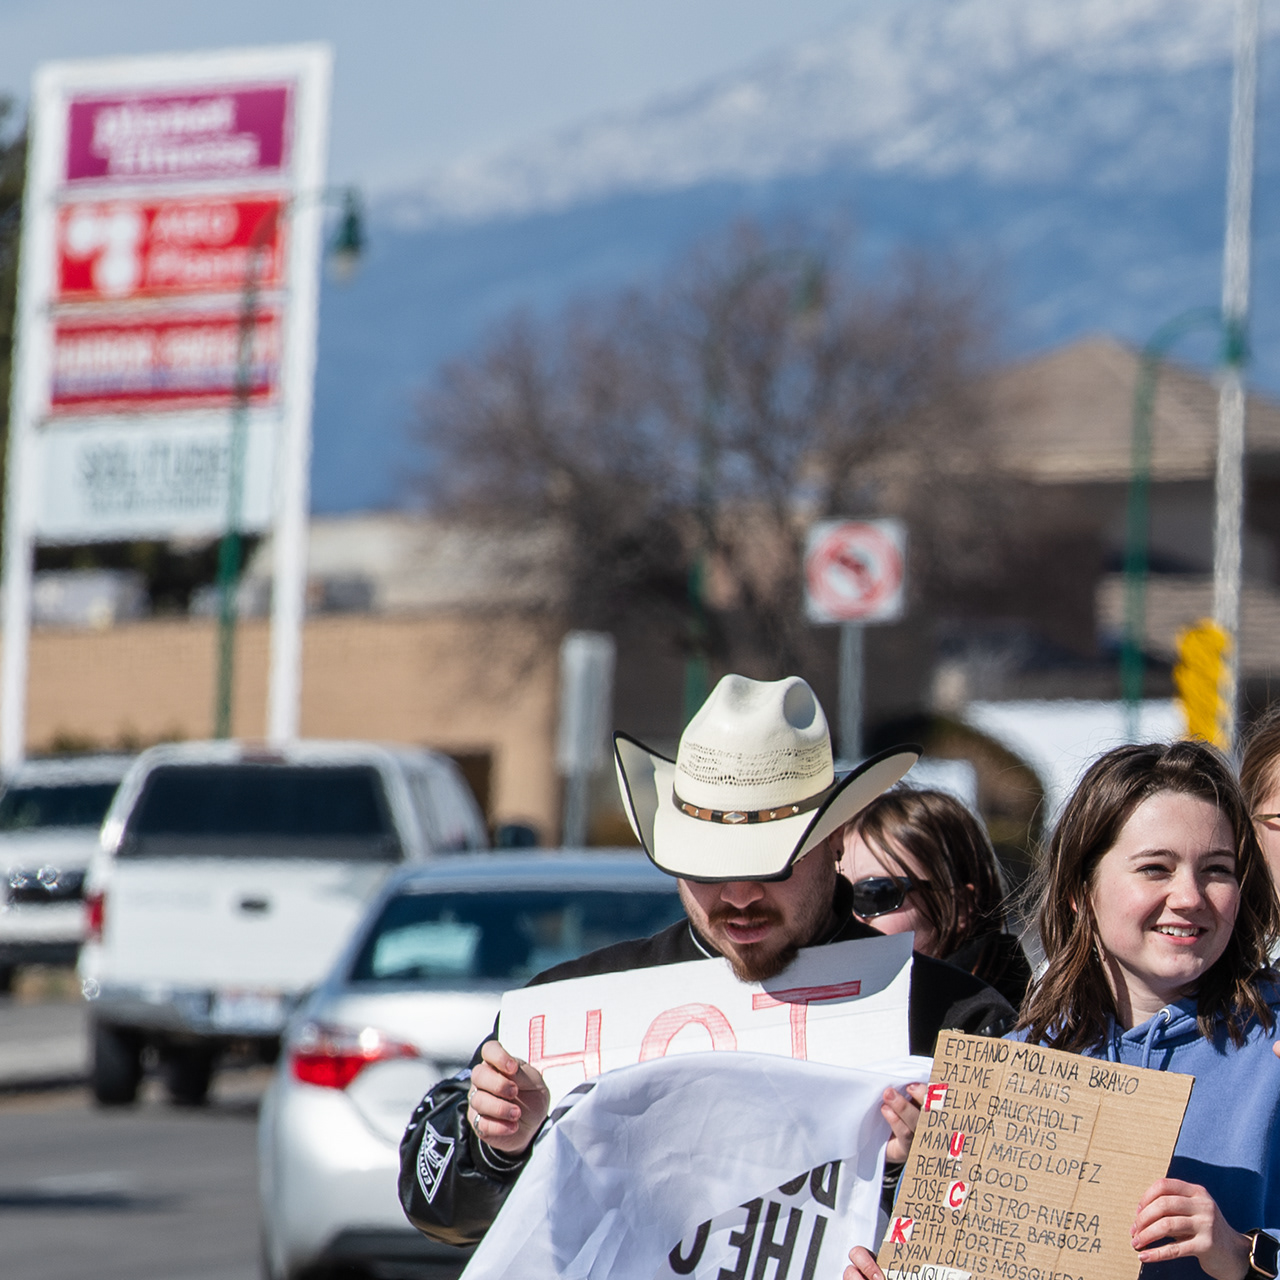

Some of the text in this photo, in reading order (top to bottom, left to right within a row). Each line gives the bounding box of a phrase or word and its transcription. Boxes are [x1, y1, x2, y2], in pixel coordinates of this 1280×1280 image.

[939, 1061, 1071, 1104] JAIME ALANIS
[945, 1038, 1139, 1095] EPIFANO MOLINA BRAVO
[924, 1083, 1083, 1134] FELIX BAUCKHOLT
[927, 1110, 948, 1130] DR
[951, 1113, 995, 1137] LINDA
[915, 1154, 1028, 1192] RENEE GOOD
[919, 1131, 1102, 1184] MANUEL MATEO LOPEZ
[901, 1201, 1102, 1254] ISAIS SANCHEZ BARBOZA
[907, 1177, 1100, 1236] JOSE CASTRO-RIVERA
[889, 1217, 1027, 1263] KEITH PORTER
[893, 1242, 931, 1262] RYAN
[935, 1247, 987, 1273] LOUIS
